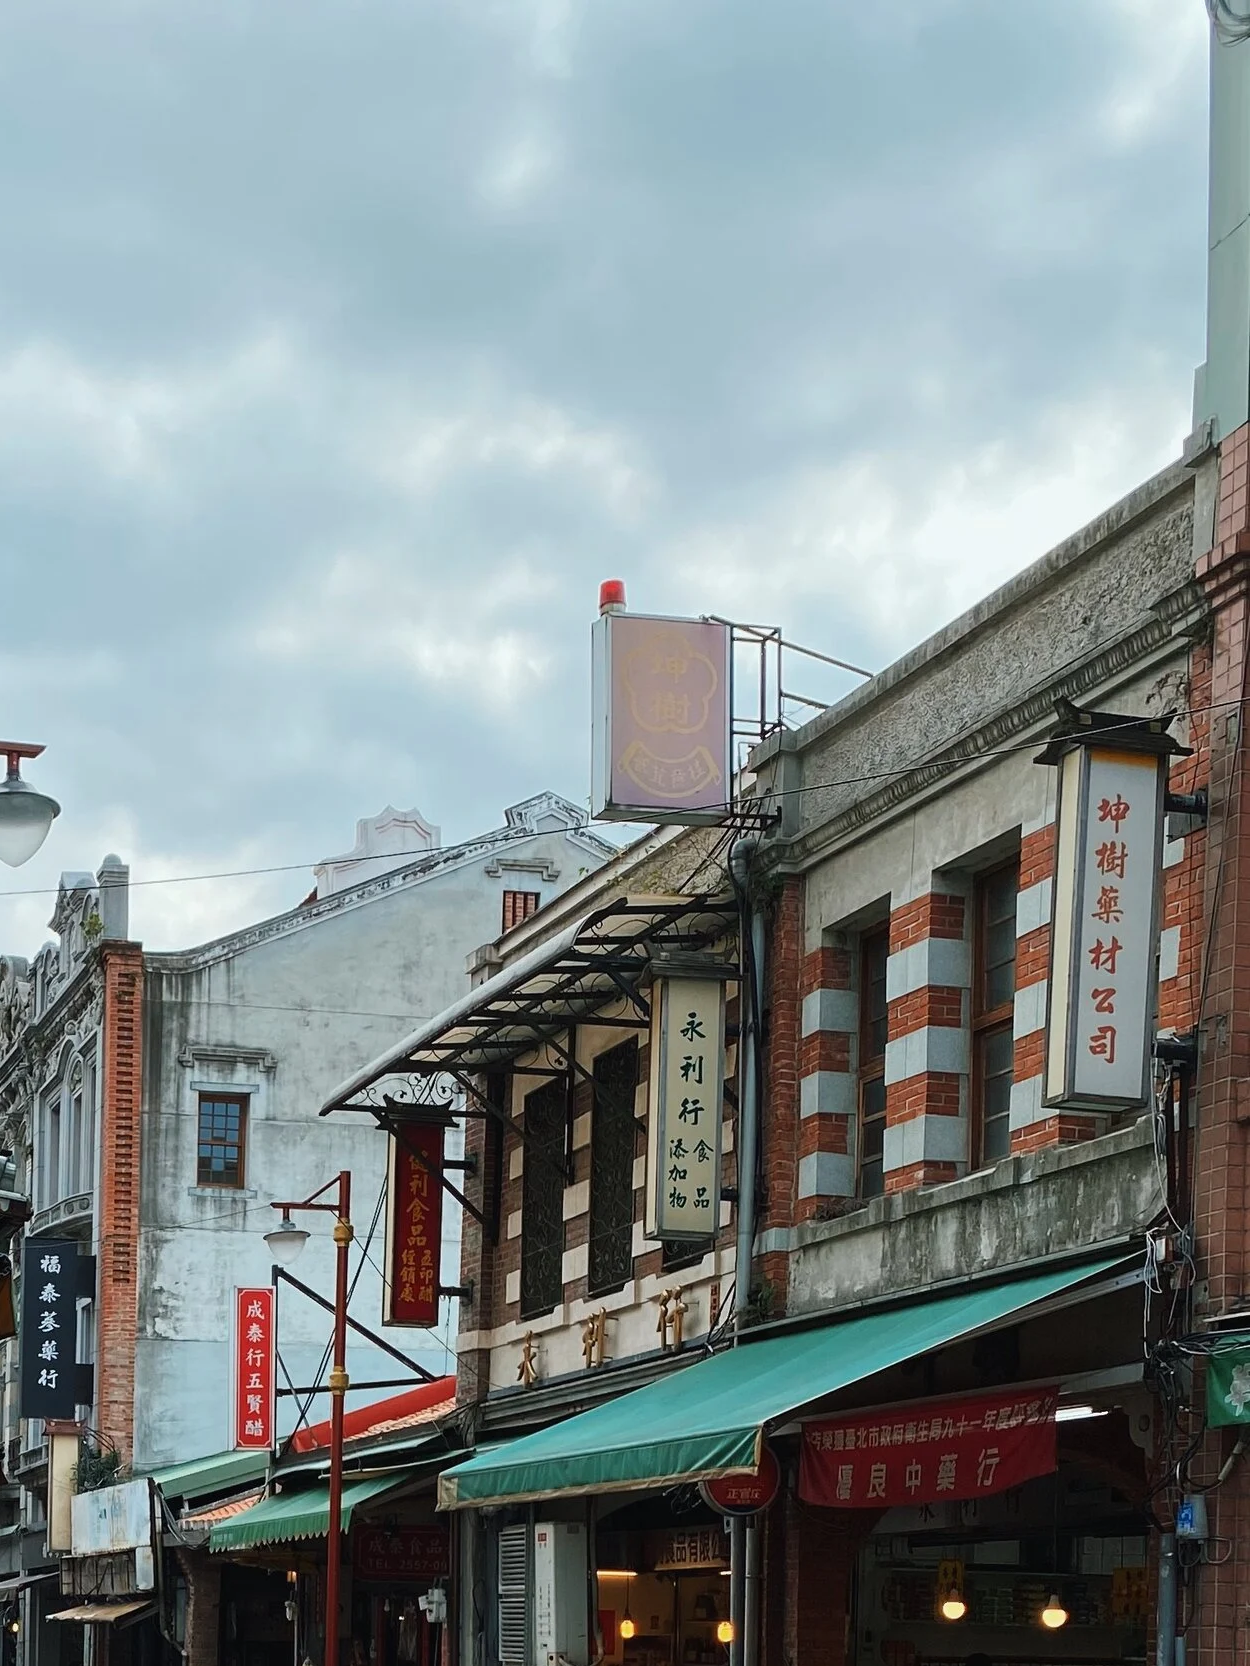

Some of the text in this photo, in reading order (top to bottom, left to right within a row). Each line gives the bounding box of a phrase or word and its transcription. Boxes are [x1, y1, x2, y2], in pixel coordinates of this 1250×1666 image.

[1088, 793, 1131, 1064] 坤樹藥材公司
[678, 1011, 707, 1126] 永利行
[667, 1138, 690, 1209] 添加物
[693, 1138, 714, 1209] 食品
[244, 1299, 266, 1437] 成泰行五賢醋
[835, 1447, 1001, 1501] 優良中藥行
